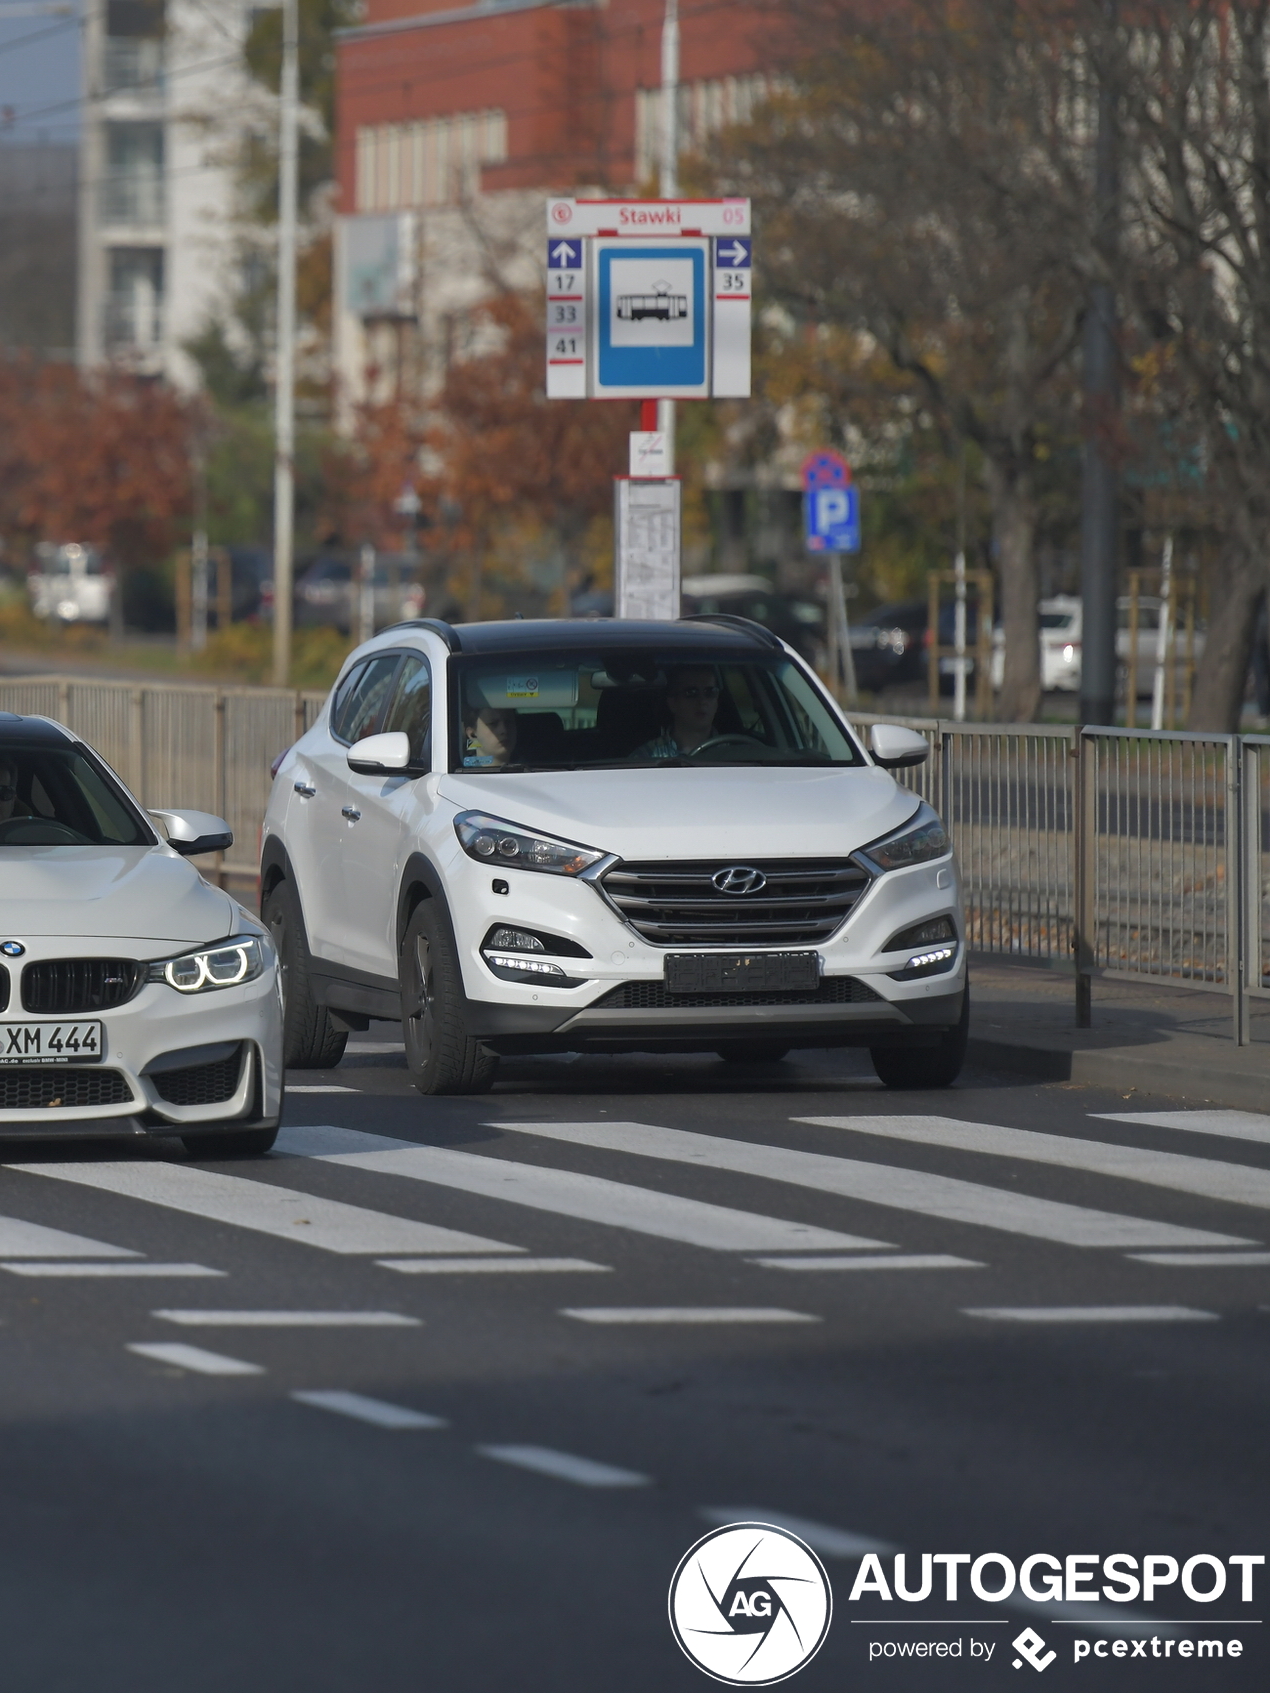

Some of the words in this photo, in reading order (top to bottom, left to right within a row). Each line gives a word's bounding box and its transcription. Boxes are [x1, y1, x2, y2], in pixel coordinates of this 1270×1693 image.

[619, 207, 681, 225] Stawki
[723, 208, 744, 225] 05
[555, 274, 575, 291] 17
[723, 274, 744, 291] 35
[555, 306, 576, 323] 33
[556, 338, 576, 354] 41
[816, 490, 849, 534] P
[6, 1028, 41, 1054] XM
[48, 1026, 97, 1053] 444
